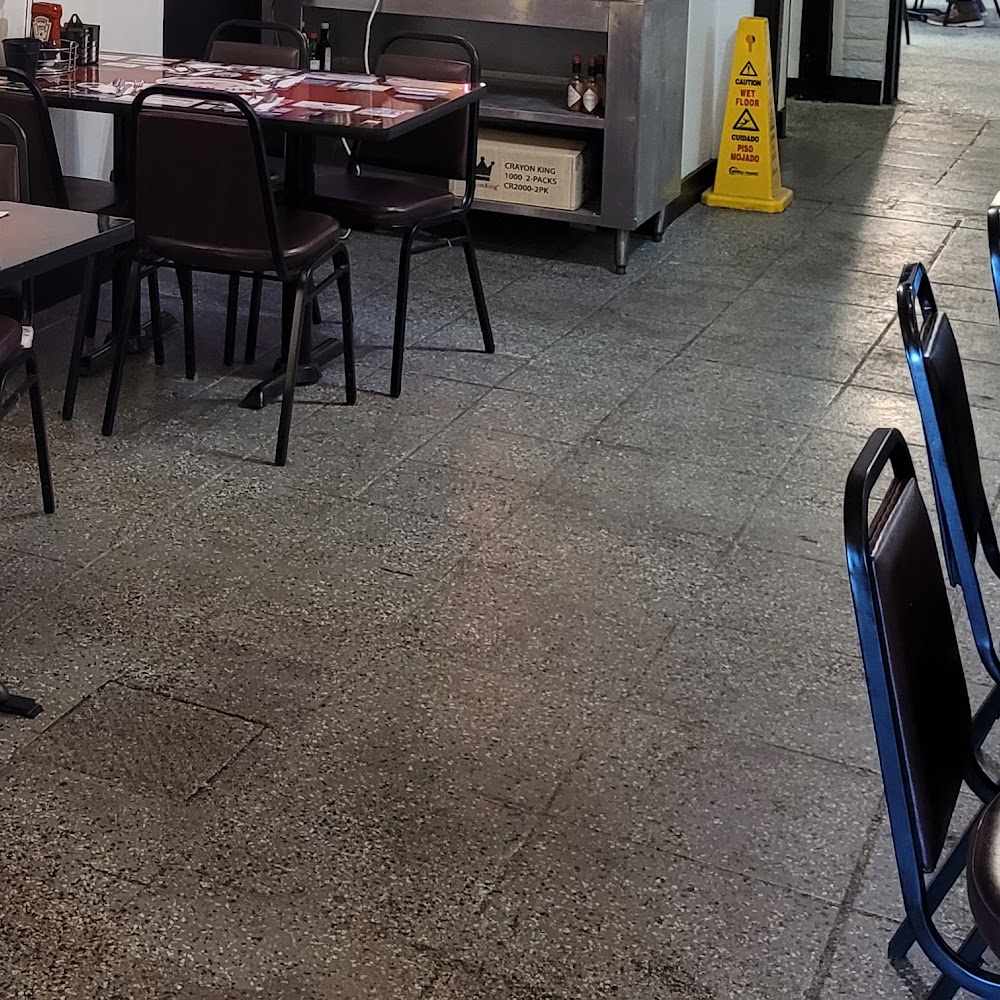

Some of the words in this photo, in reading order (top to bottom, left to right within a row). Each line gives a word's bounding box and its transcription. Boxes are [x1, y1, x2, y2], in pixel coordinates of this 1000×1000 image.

[735, 78, 761, 86] CAUTION
[740, 89, 755, 97] WET
[735, 98, 759, 107] FLOOR
[731, 134, 759, 142] CUIDADO
[737, 144, 753, 153] PISO
[730, 153, 759, 162] MOJADO
[504, 162, 536, 172] CRAYON
[536, 166, 556, 175] KING
[505, 172, 523, 180] 1000
[525, 175, 558, 185] 2-PACKS
[503, 182, 549, 194] CR2000-2PK
